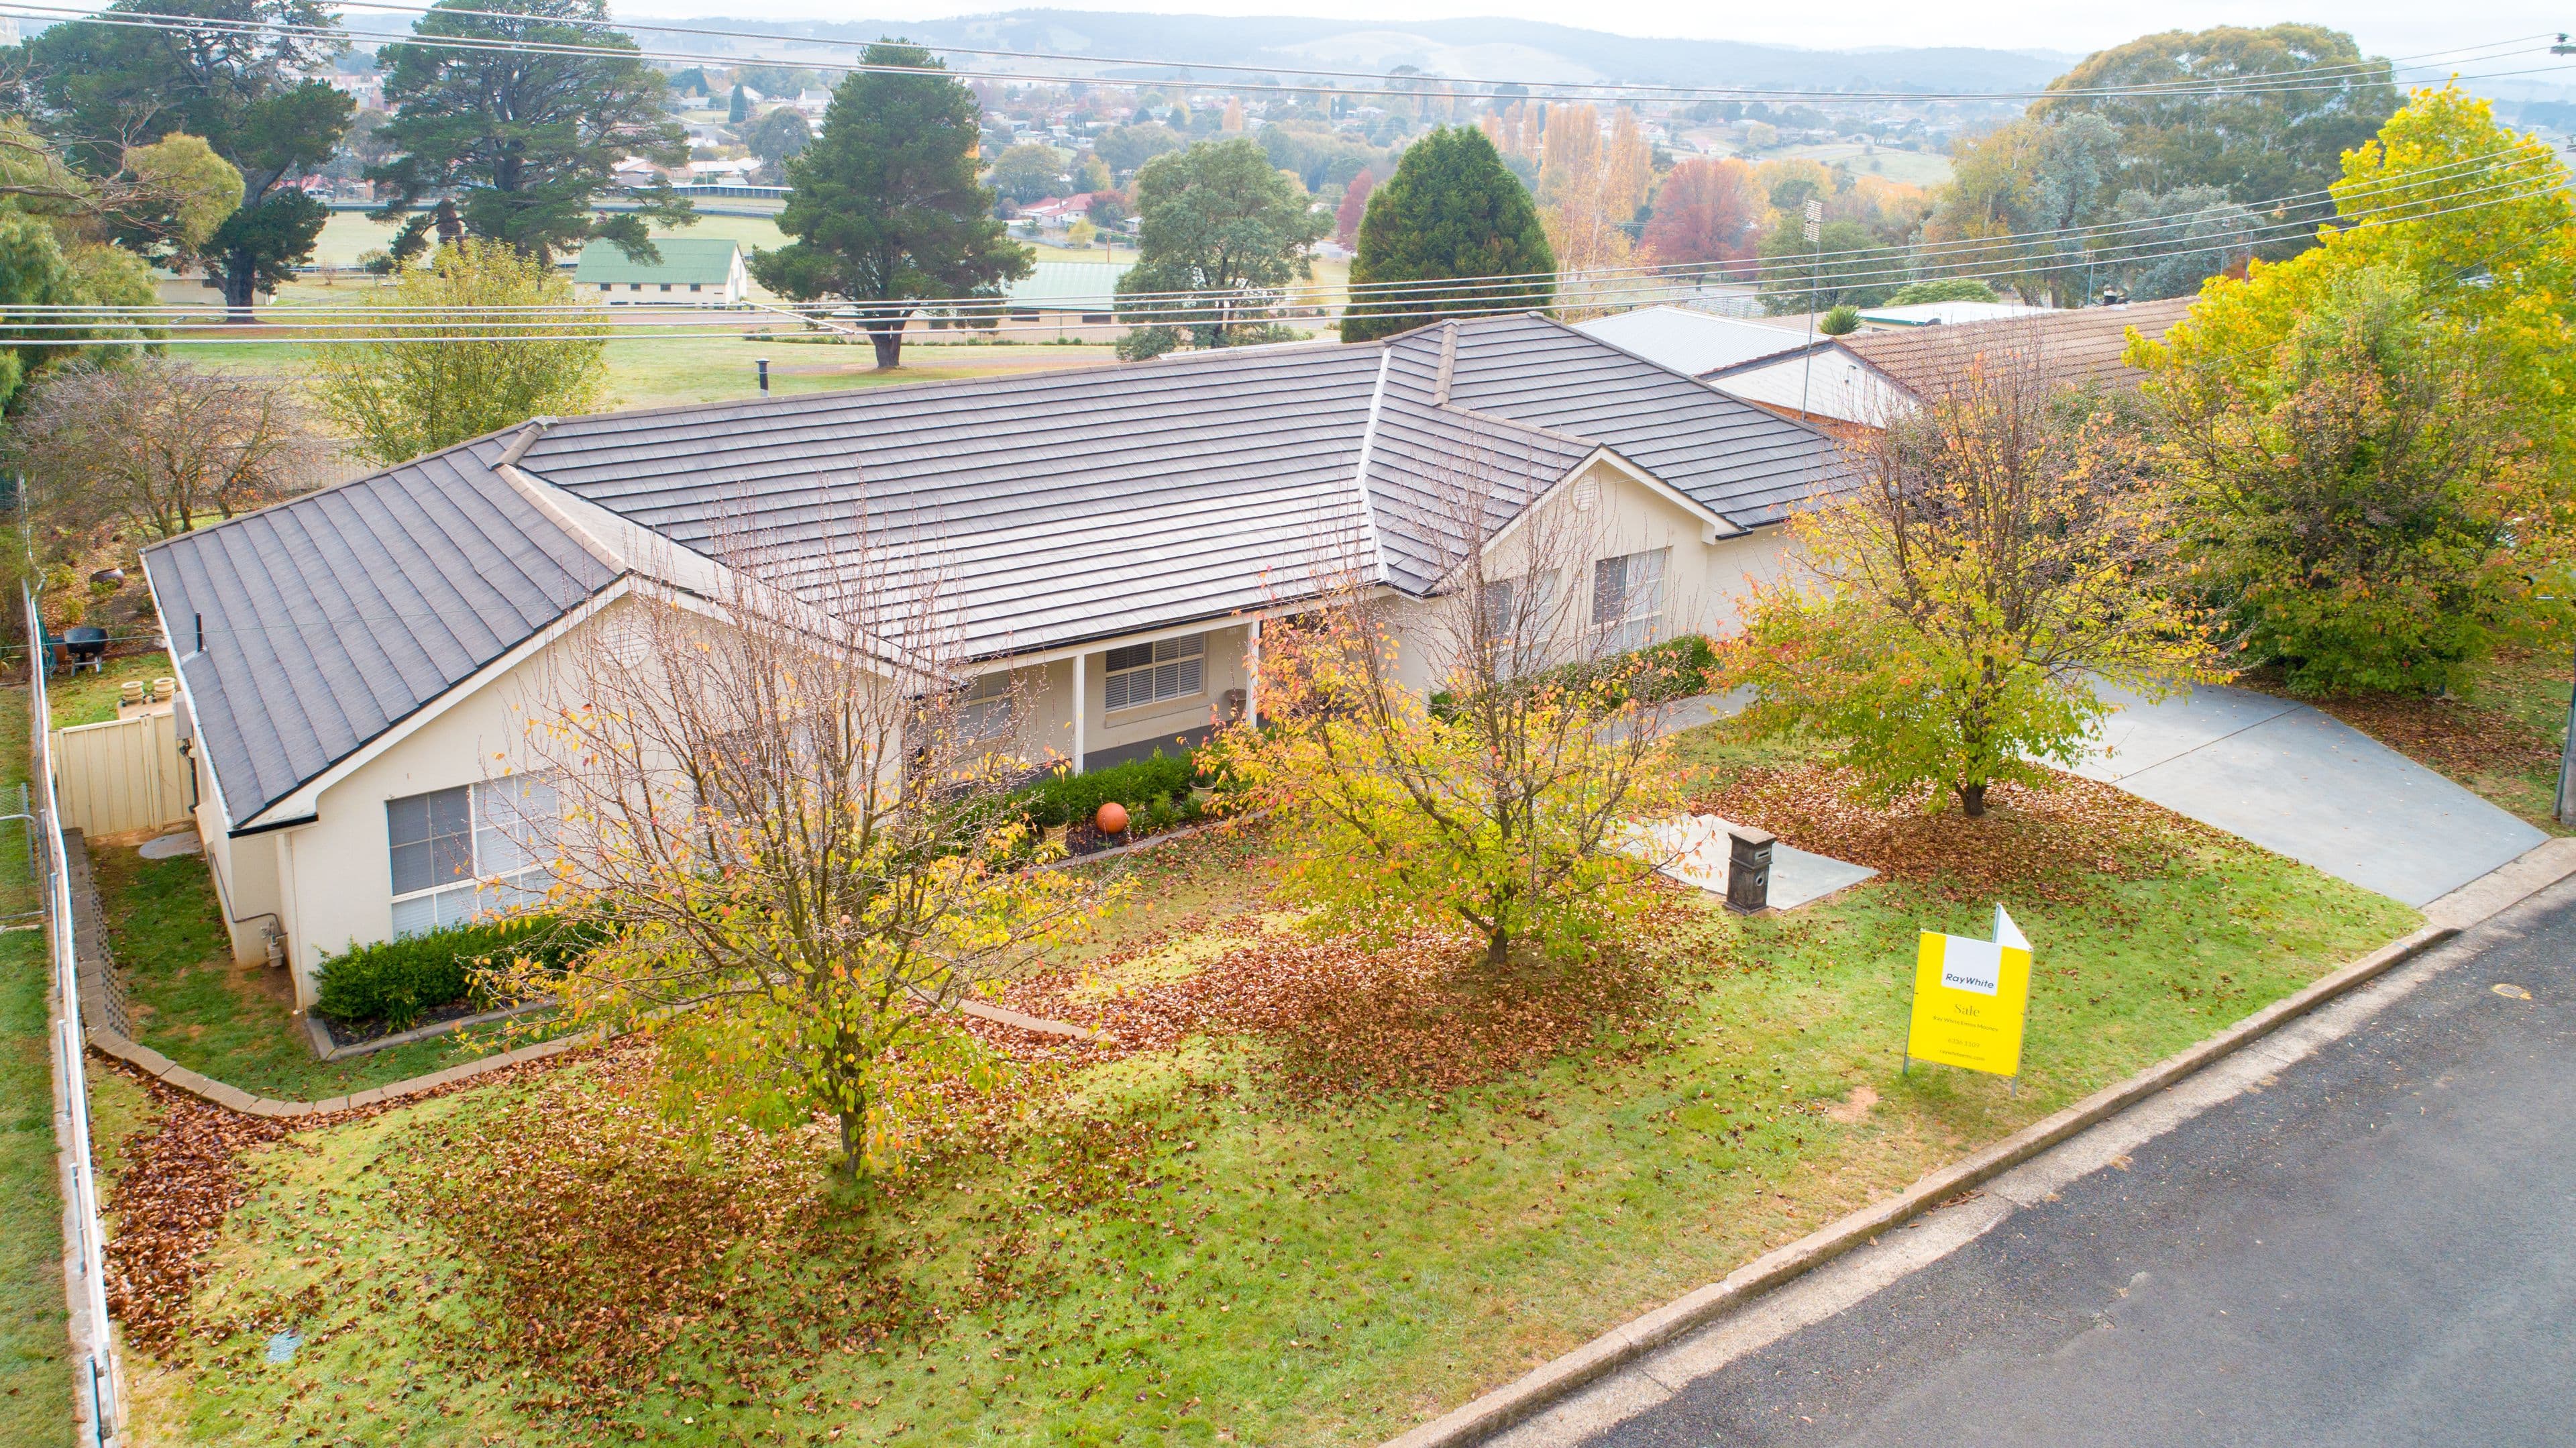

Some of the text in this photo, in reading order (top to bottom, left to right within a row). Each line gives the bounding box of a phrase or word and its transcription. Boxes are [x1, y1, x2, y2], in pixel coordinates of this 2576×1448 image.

[1945, 973, 1994, 988] RayWhite
[1954, 1003, 1980, 1017] Sale
[1944, 1017, 1960, 1025] White
